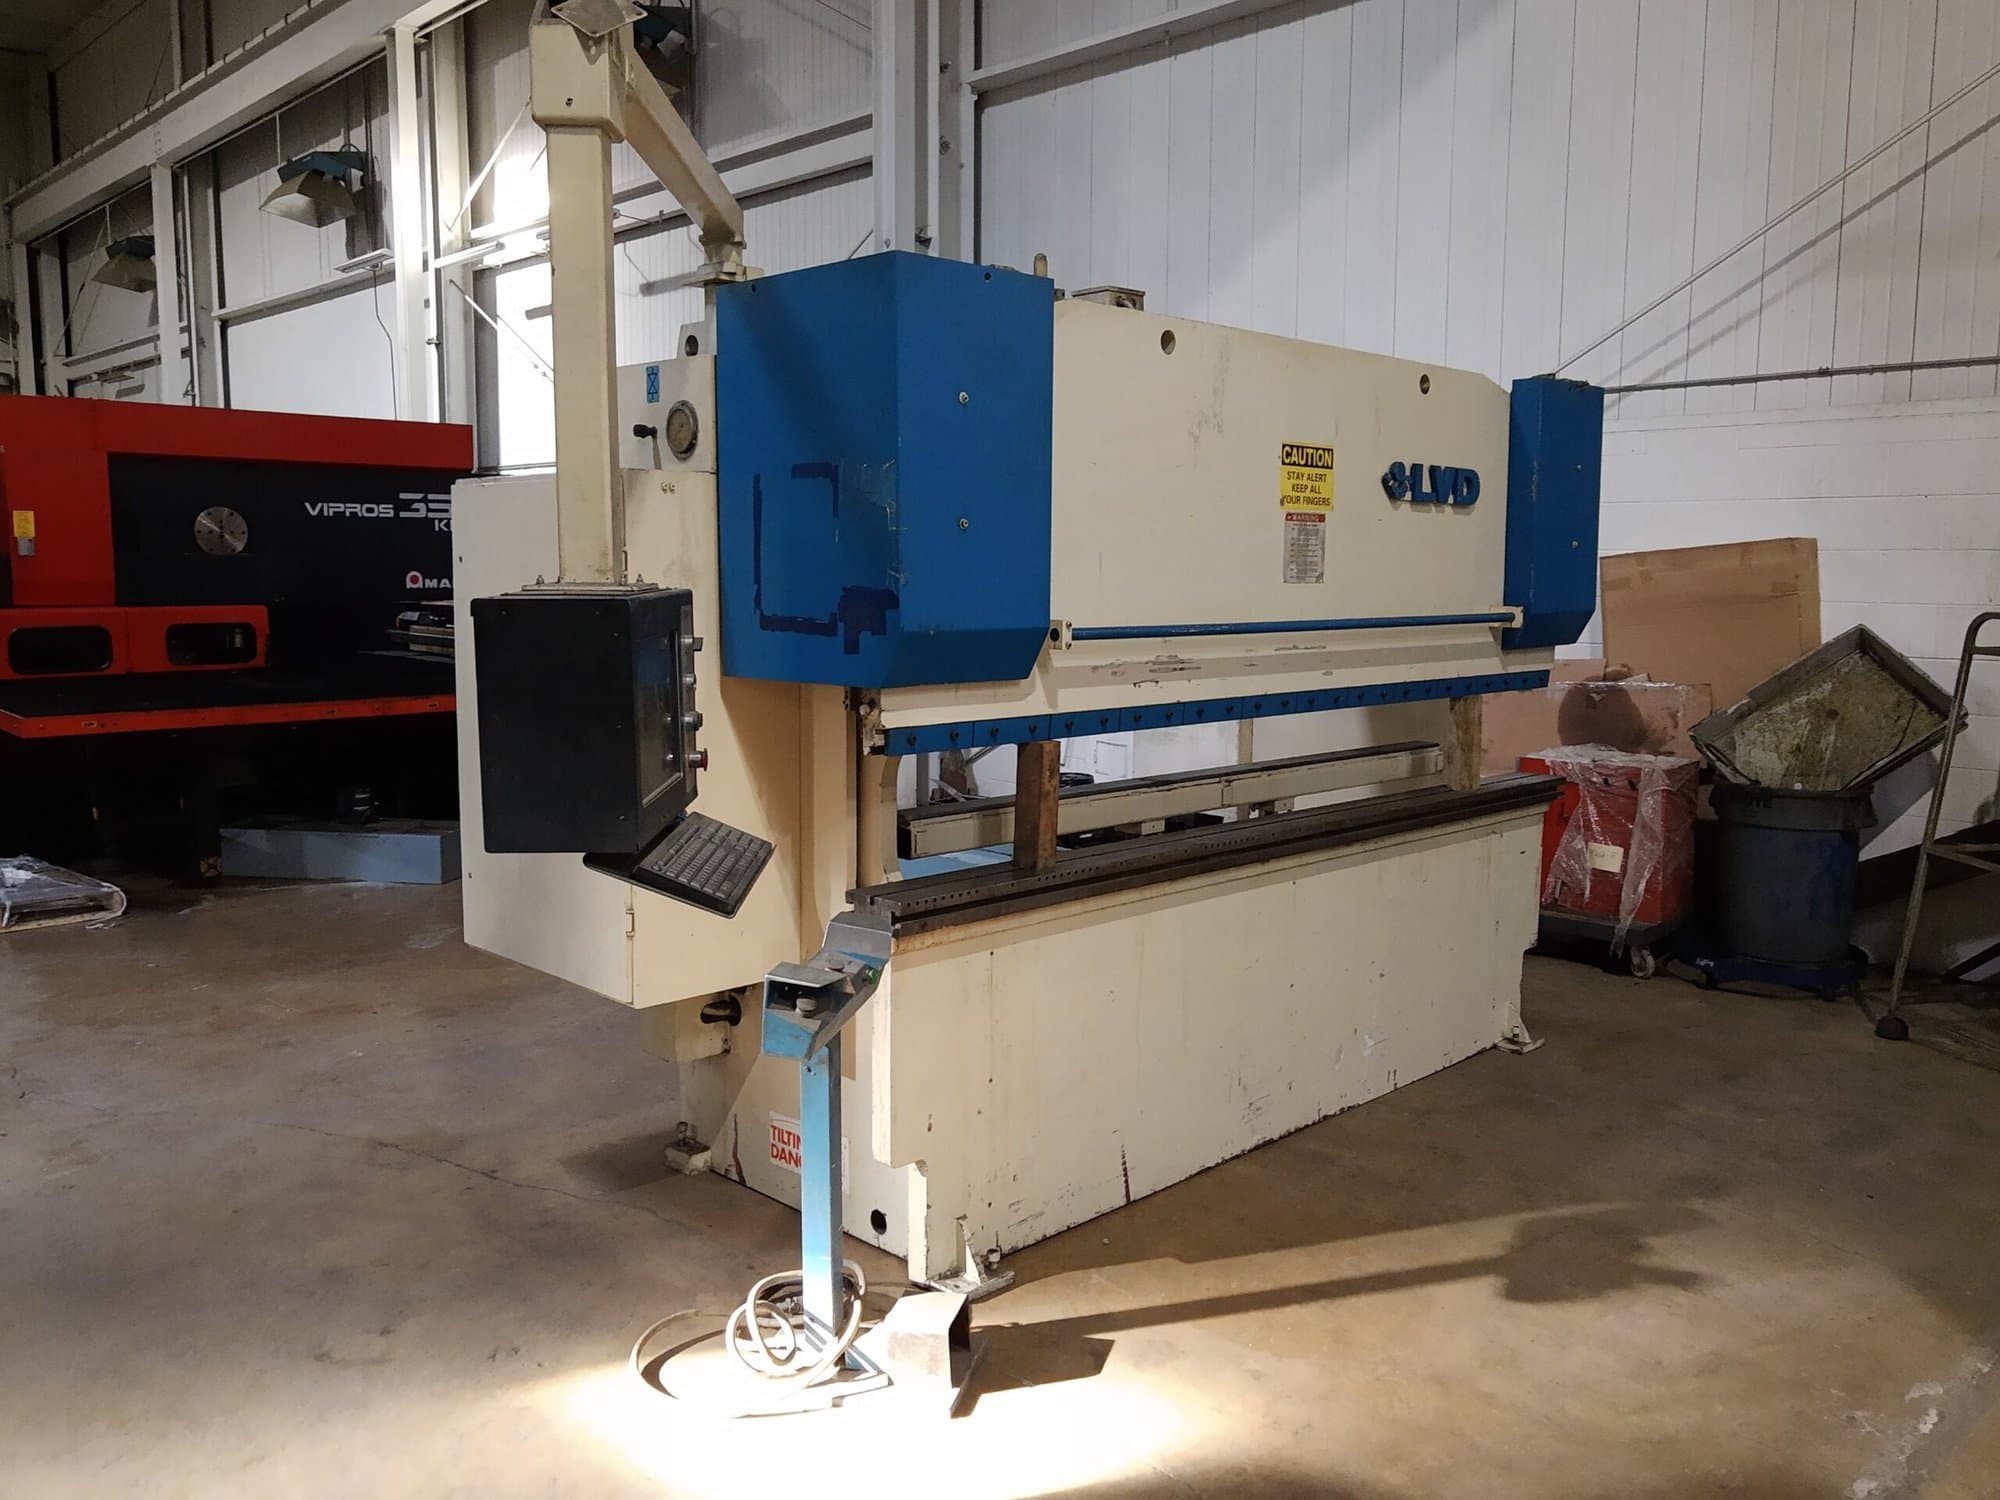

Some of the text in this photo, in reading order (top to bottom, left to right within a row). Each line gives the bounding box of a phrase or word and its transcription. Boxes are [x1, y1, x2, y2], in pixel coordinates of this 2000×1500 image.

[1283, 446, 1332, 467] CAUTION
[1287, 471, 1327, 483] STAY ALERT
[1410, 463, 1480, 506] LVD
[1292, 484, 1322, 494] KEEP ALL
[1303, 496, 1331, 506] FINGERS
[304, 502, 394, 517] VIPROS
[771, 1142, 802, 1169] DAN
